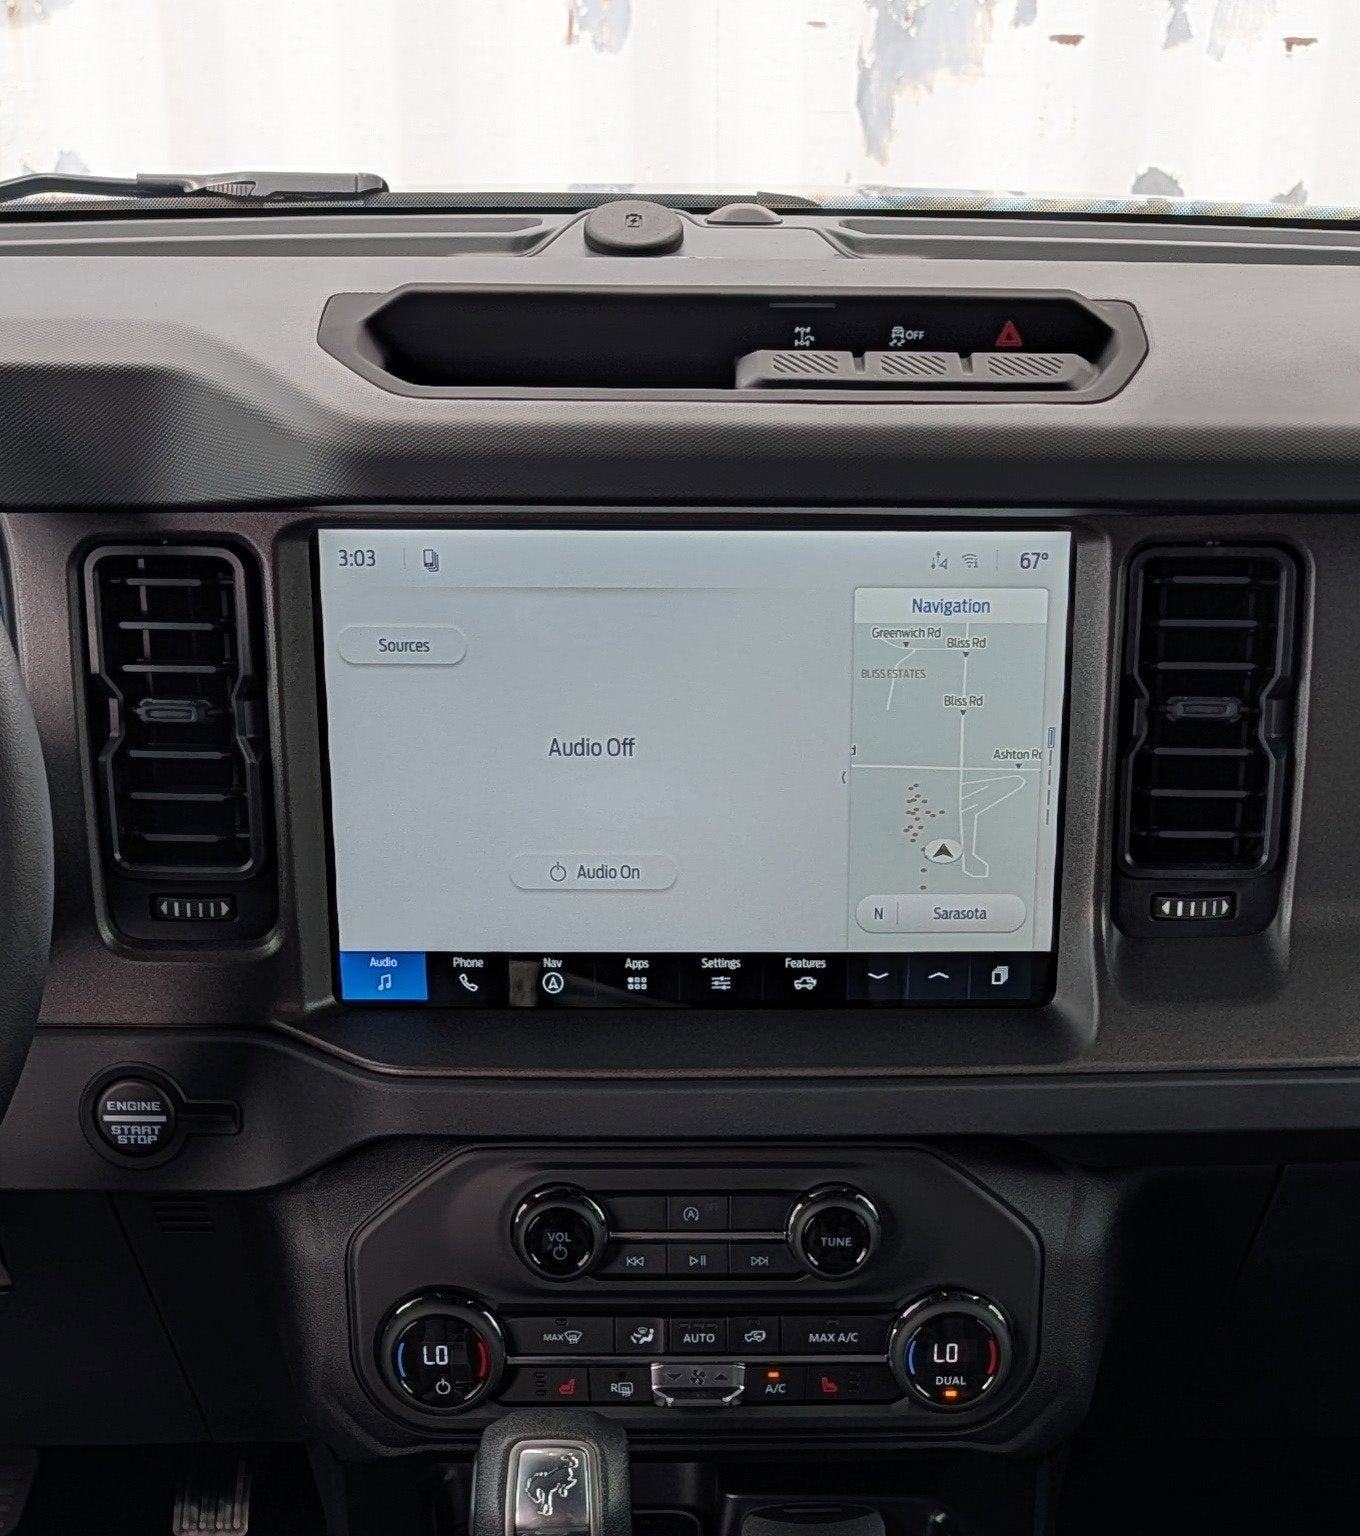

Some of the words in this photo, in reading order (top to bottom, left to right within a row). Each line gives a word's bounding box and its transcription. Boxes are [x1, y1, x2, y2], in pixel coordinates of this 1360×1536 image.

[905, 330, 925, 341] OFF
[338, 549, 376, 567] 3:03
[1019, 552, 1049, 570] 67°
[911, 598, 991, 616] Navigation
[871, 627, 926, 639] Greenwich
[927, 627, 942, 639] Rd
[378, 638, 431, 653] Sources
[946, 637, 971, 649] Bliss
[971, 637, 987, 649] Rd
[886, 669, 927, 679] ESTATES
[943, 695, 968, 707] Bliss
[969, 695, 984, 707] Rd
[548, 737, 602, 757] Audio
[606, 737, 636, 757] Off
[993, 749, 1030, 760] Ashton
[576, 864, 617, 880] Audio
[619, 864, 641, 880] On
[873, 907, 884, 920] N
[932, 906, 988, 920] Sarasota
[368, 956, 398, 969] Audio
[452, 956, 484, 969] Phone
[542, 957, 563, 969] Nav
[624, 957, 650, 971] Apps
[700, 957, 742, 971] Settings
[784, 957, 827, 970] Features
[106, 1101, 162, 1112] ENGINE
[110, 1125, 162, 1135] START
[117, 1135, 158, 1146] STOP
[546, 1231, 572, 1243] VOL
[820, 1236, 853, 1247] TUNE
[542, 1333, 564, 1342] MAX
[682, 1332, 716, 1344] AUTO
[808, 1332, 836, 1343] MAX
[836, 1332, 859, 1344] A/C
[934, 1375, 967, 1386] DUAL
[764, 1382, 787, 1394] A/C
